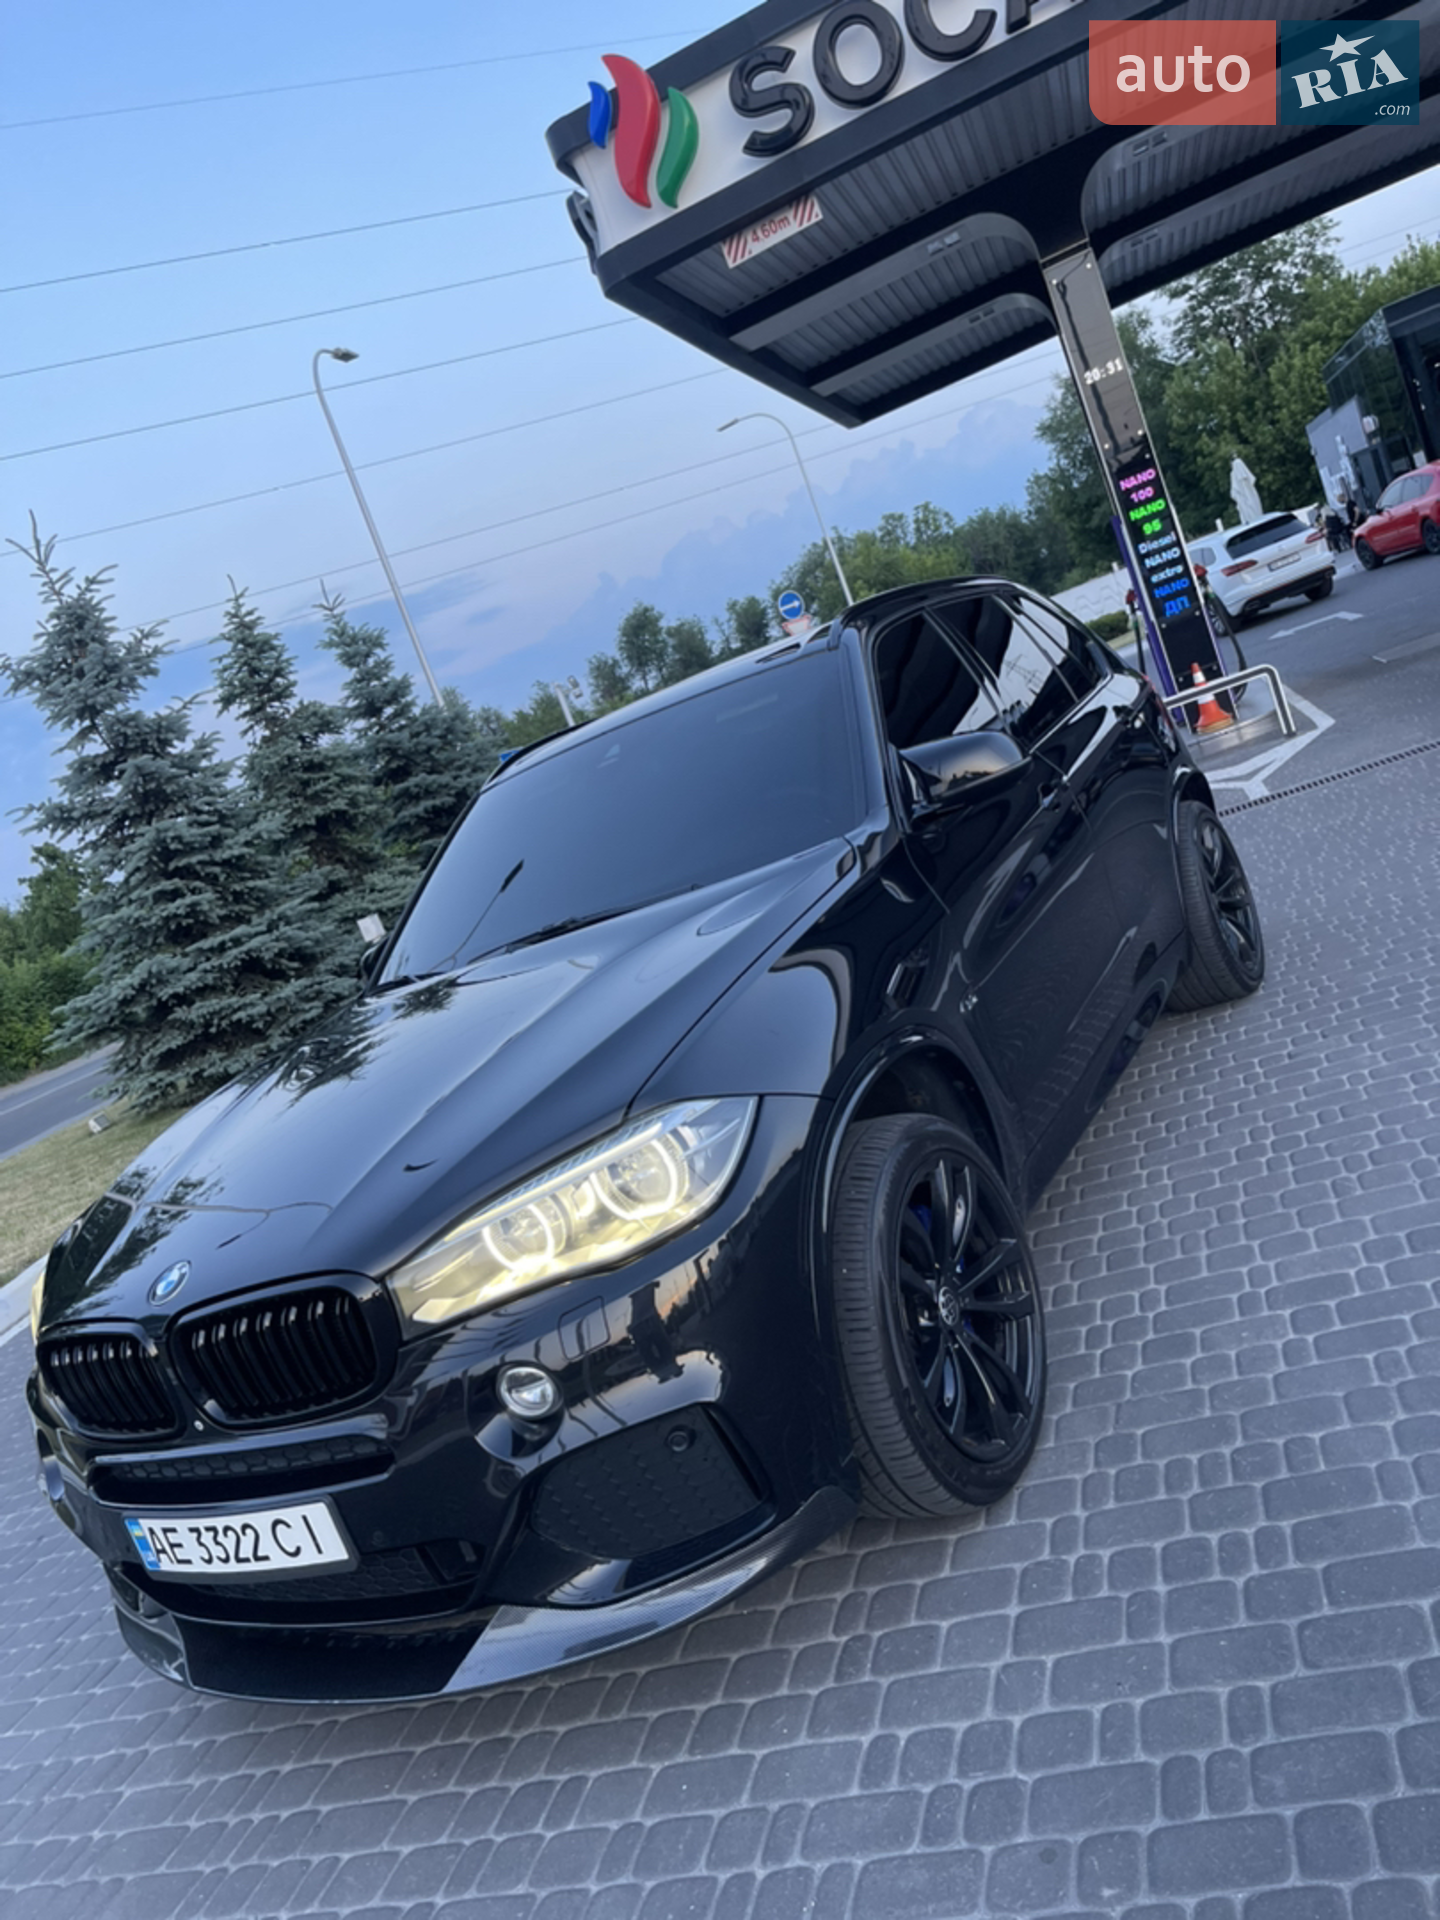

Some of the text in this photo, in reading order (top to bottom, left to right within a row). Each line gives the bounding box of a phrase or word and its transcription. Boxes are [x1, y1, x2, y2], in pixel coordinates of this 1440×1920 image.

[729, 0, 1076, 157] SOC
[1083, 357, 1123, 385] 20:31
[1119, 468, 1156, 491] NANO
[1130, 486, 1154, 503] 100
[1129, 498, 1166, 521] NANO
[1143, 518, 1161, 535] 95
[1138, 531, 1176, 554] Diesel
[1145, 547, 1181, 568] NANO
[1154, 578, 1189, 598] NANO
[1166, 596, 1190, 618] ДП
[148, 1526, 193, 1565] AE
[188, 1522, 270, 1565] 3322
